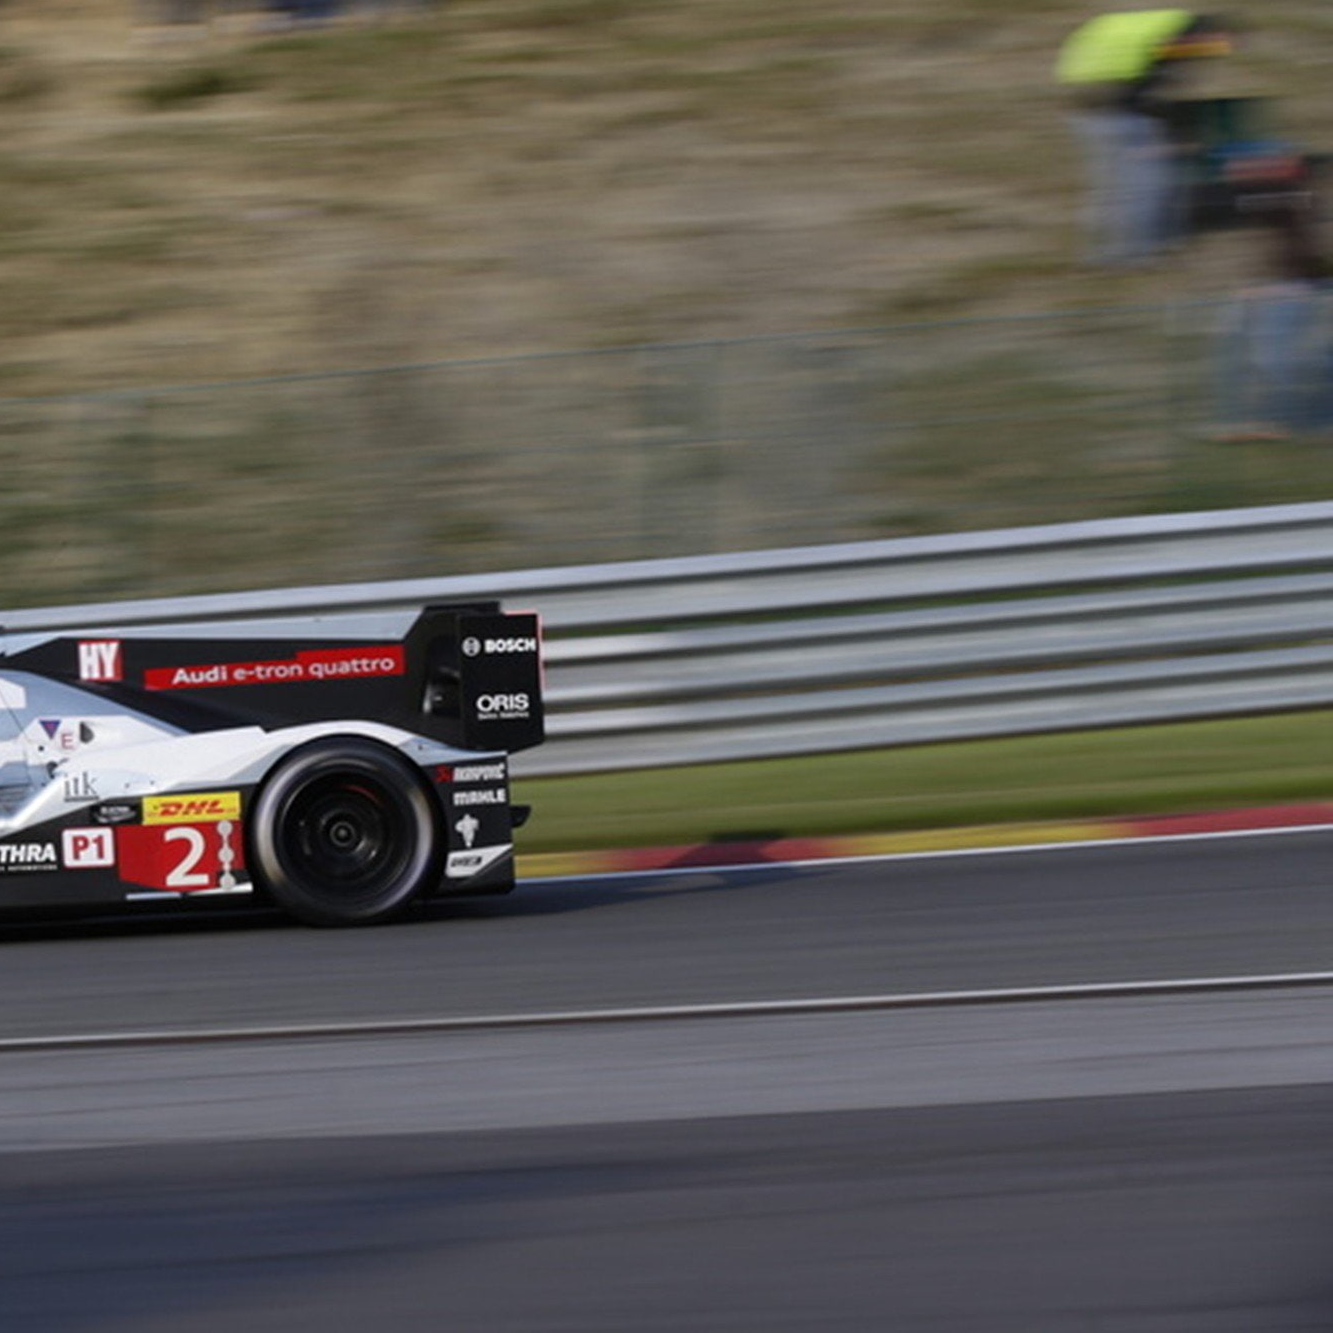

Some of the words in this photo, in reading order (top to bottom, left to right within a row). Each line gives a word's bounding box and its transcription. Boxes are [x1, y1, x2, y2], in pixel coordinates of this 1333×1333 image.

[484, 638, 536, 653] BOSCH
[79, 642, 119, 679] HY
[172, 665, 228, 684] Audi
[233, 663, 303, 680] e-tron
[309, 656, 395, 678] quattro
[476, 693, 529, 712] ORIS
[61, 733, 74, 750] E
[159, 799, 225, 816] DHL
[72, 834, 105, 861] P1
[164, 827, 210, 887] 2
